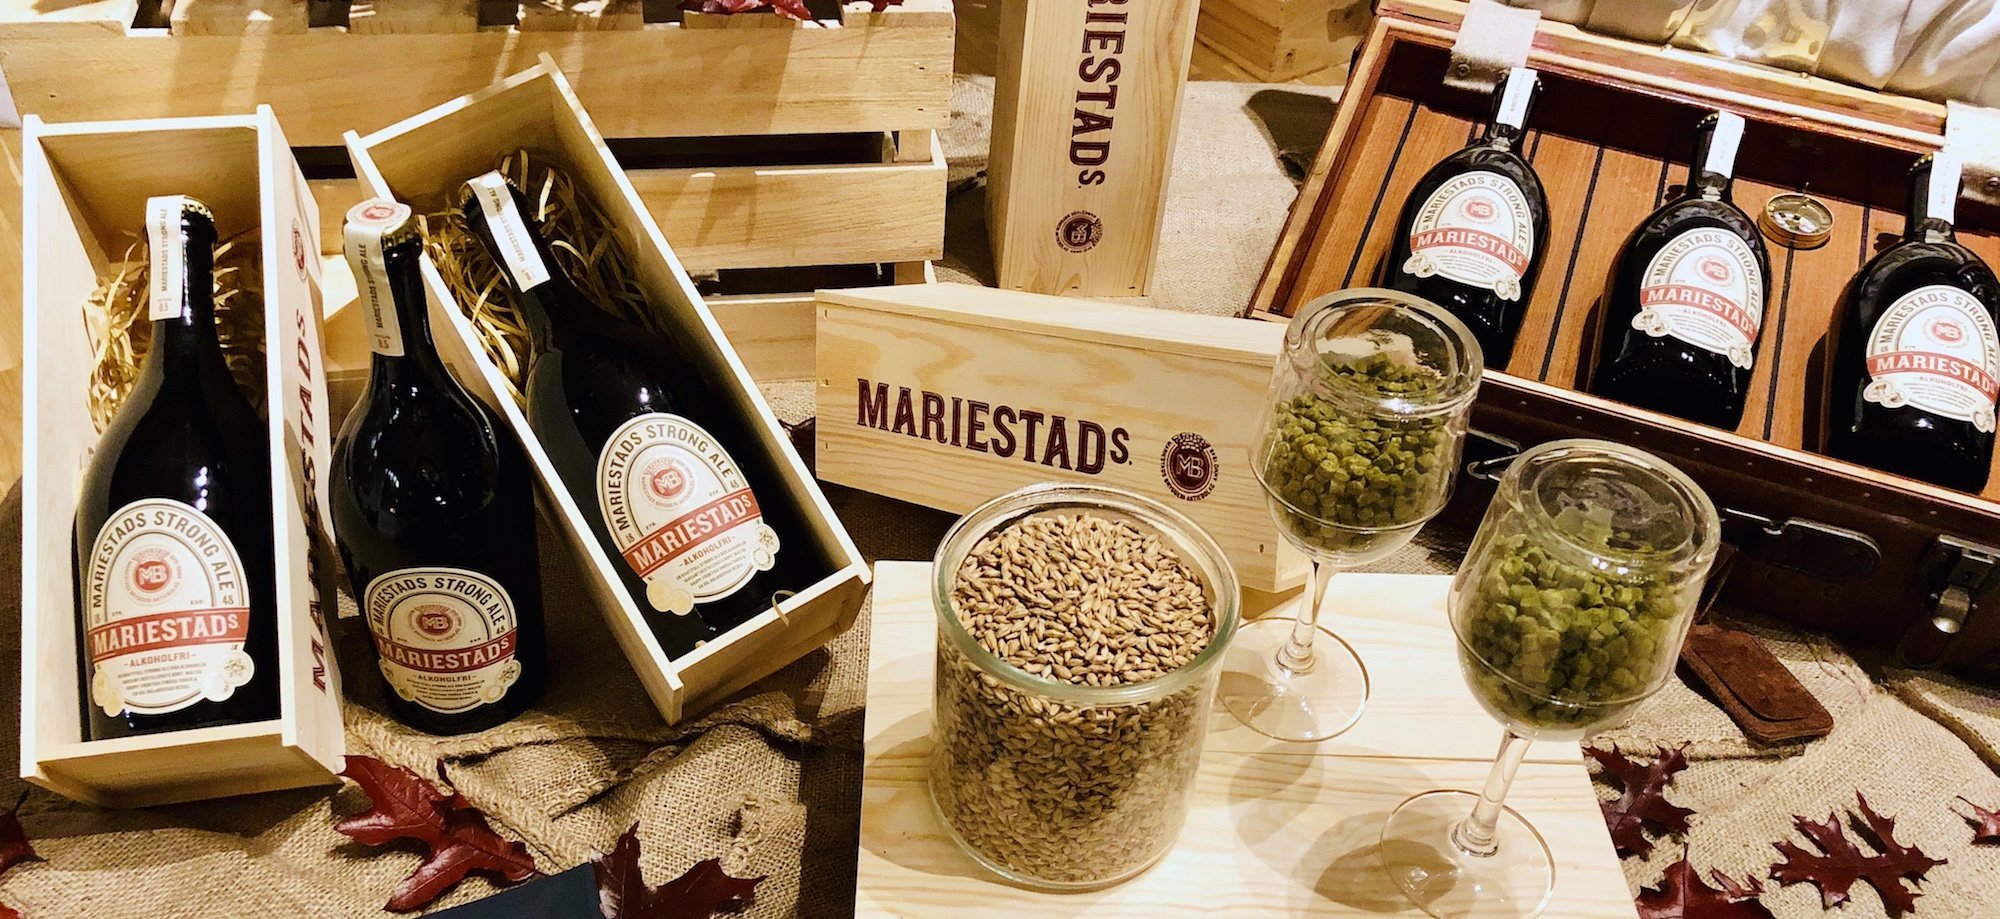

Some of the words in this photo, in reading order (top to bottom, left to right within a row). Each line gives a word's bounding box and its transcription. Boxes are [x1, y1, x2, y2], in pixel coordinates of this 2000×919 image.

[1423, 177, 1486, 223] MARIESTADS
[1489, 179, 1526, 219] STRONG
[1517, 221, 1527, 243] ALE
[1417, 231, 1524, 266] MARIESTADS
[1654, 234, 1722, 277] MARIESTADS
[1727, 240, 1758, 286] STRONG
[1879, 293, 1948, 344] MARIESTADS
[1954, 296, 1994, 341] STRONG
[608, 431, 643, 531] MARIESTADS
[647, 423, 709, 454] STRONG
[709, 452, 734, 478] ALE
[652, 469, 683, 494] MB
[1176, 453, 1205, 479] MB
[632, 494, 752, 571] MARIESTADS
[92, 512, 147, 609] MARIESTADS
[153, 510, 220, 560] STRONG
[211, 561, 236, 592] ALE
[138, 564, 168, 586] MB
[372, 577, 428, 627] MARIESTADS
[434, 577, 493, 606] STRONG
[486, 602, 506, 626] ALE
[92, 612, 240, 656] MARIESTADS
[378, 637, 510, 670] MARIESTADS
